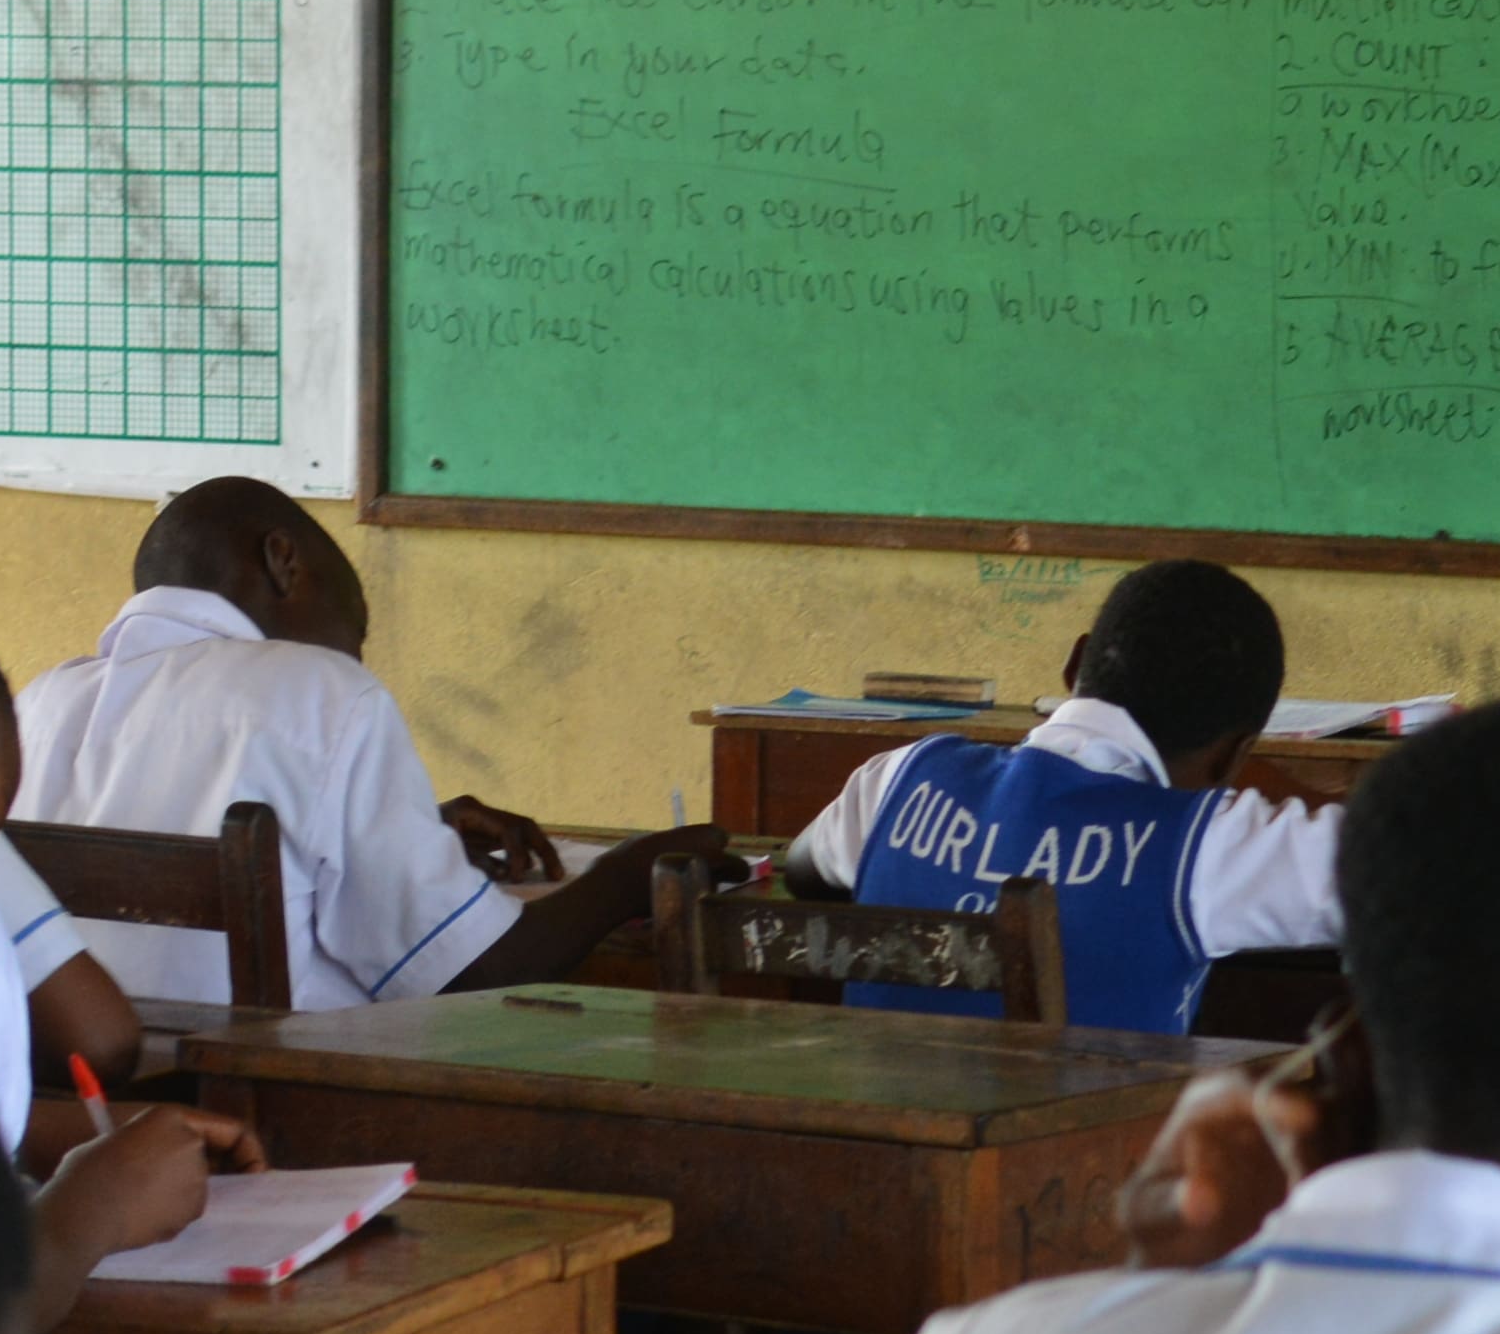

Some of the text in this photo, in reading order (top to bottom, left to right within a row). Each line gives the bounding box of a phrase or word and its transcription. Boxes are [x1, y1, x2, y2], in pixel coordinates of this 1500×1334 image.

[443, 30, 545, 90] Type
[565, 31, 599, 74] in
[621, 40, 725, 97] your
[568, 97, 685, 142] Excel
[510, 173, 655, 233] formula
[675, 183, 706, 229] is
[723, 205, 746, 233] a
[761, 196, 933, 248] equation
[955, 192, 1041, 244] that
[1059, 211, 1235, 264] performs
[404, 227, 630, 296] mathematical
[869, 268, 971, 343] using
[995, 277, 1104, 331] values
[1129, 277, 1169, 321] in
[1189, 295, 1210, 321] a
[1430, 239, 1459, 286] to
[889, 780, 1157, 886] OUR LADY
